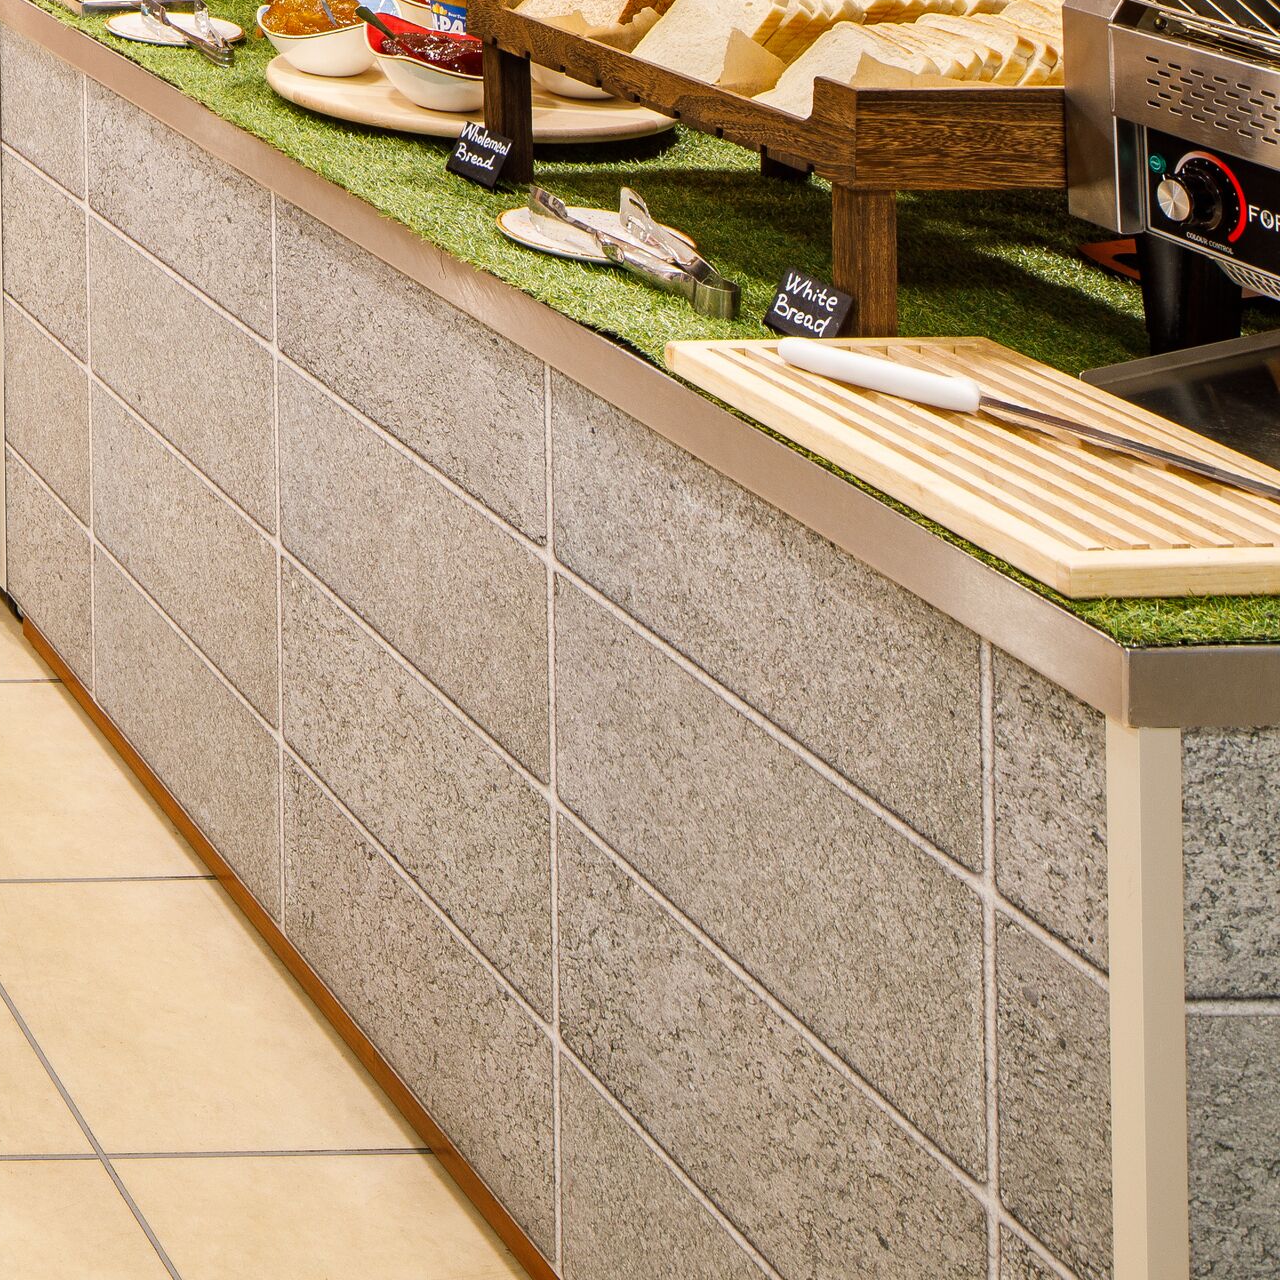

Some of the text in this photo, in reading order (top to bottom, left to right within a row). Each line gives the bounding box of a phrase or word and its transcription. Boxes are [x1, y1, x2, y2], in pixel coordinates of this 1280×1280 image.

[455, 142, 496, 170] Bread
[461, 121, 512, 156] Wholemeal
[1186, 231, 1234, 255] COLOUR CONTROL
[785, 271, 838, 312] White
[773, 293, 833, 337] Bread
